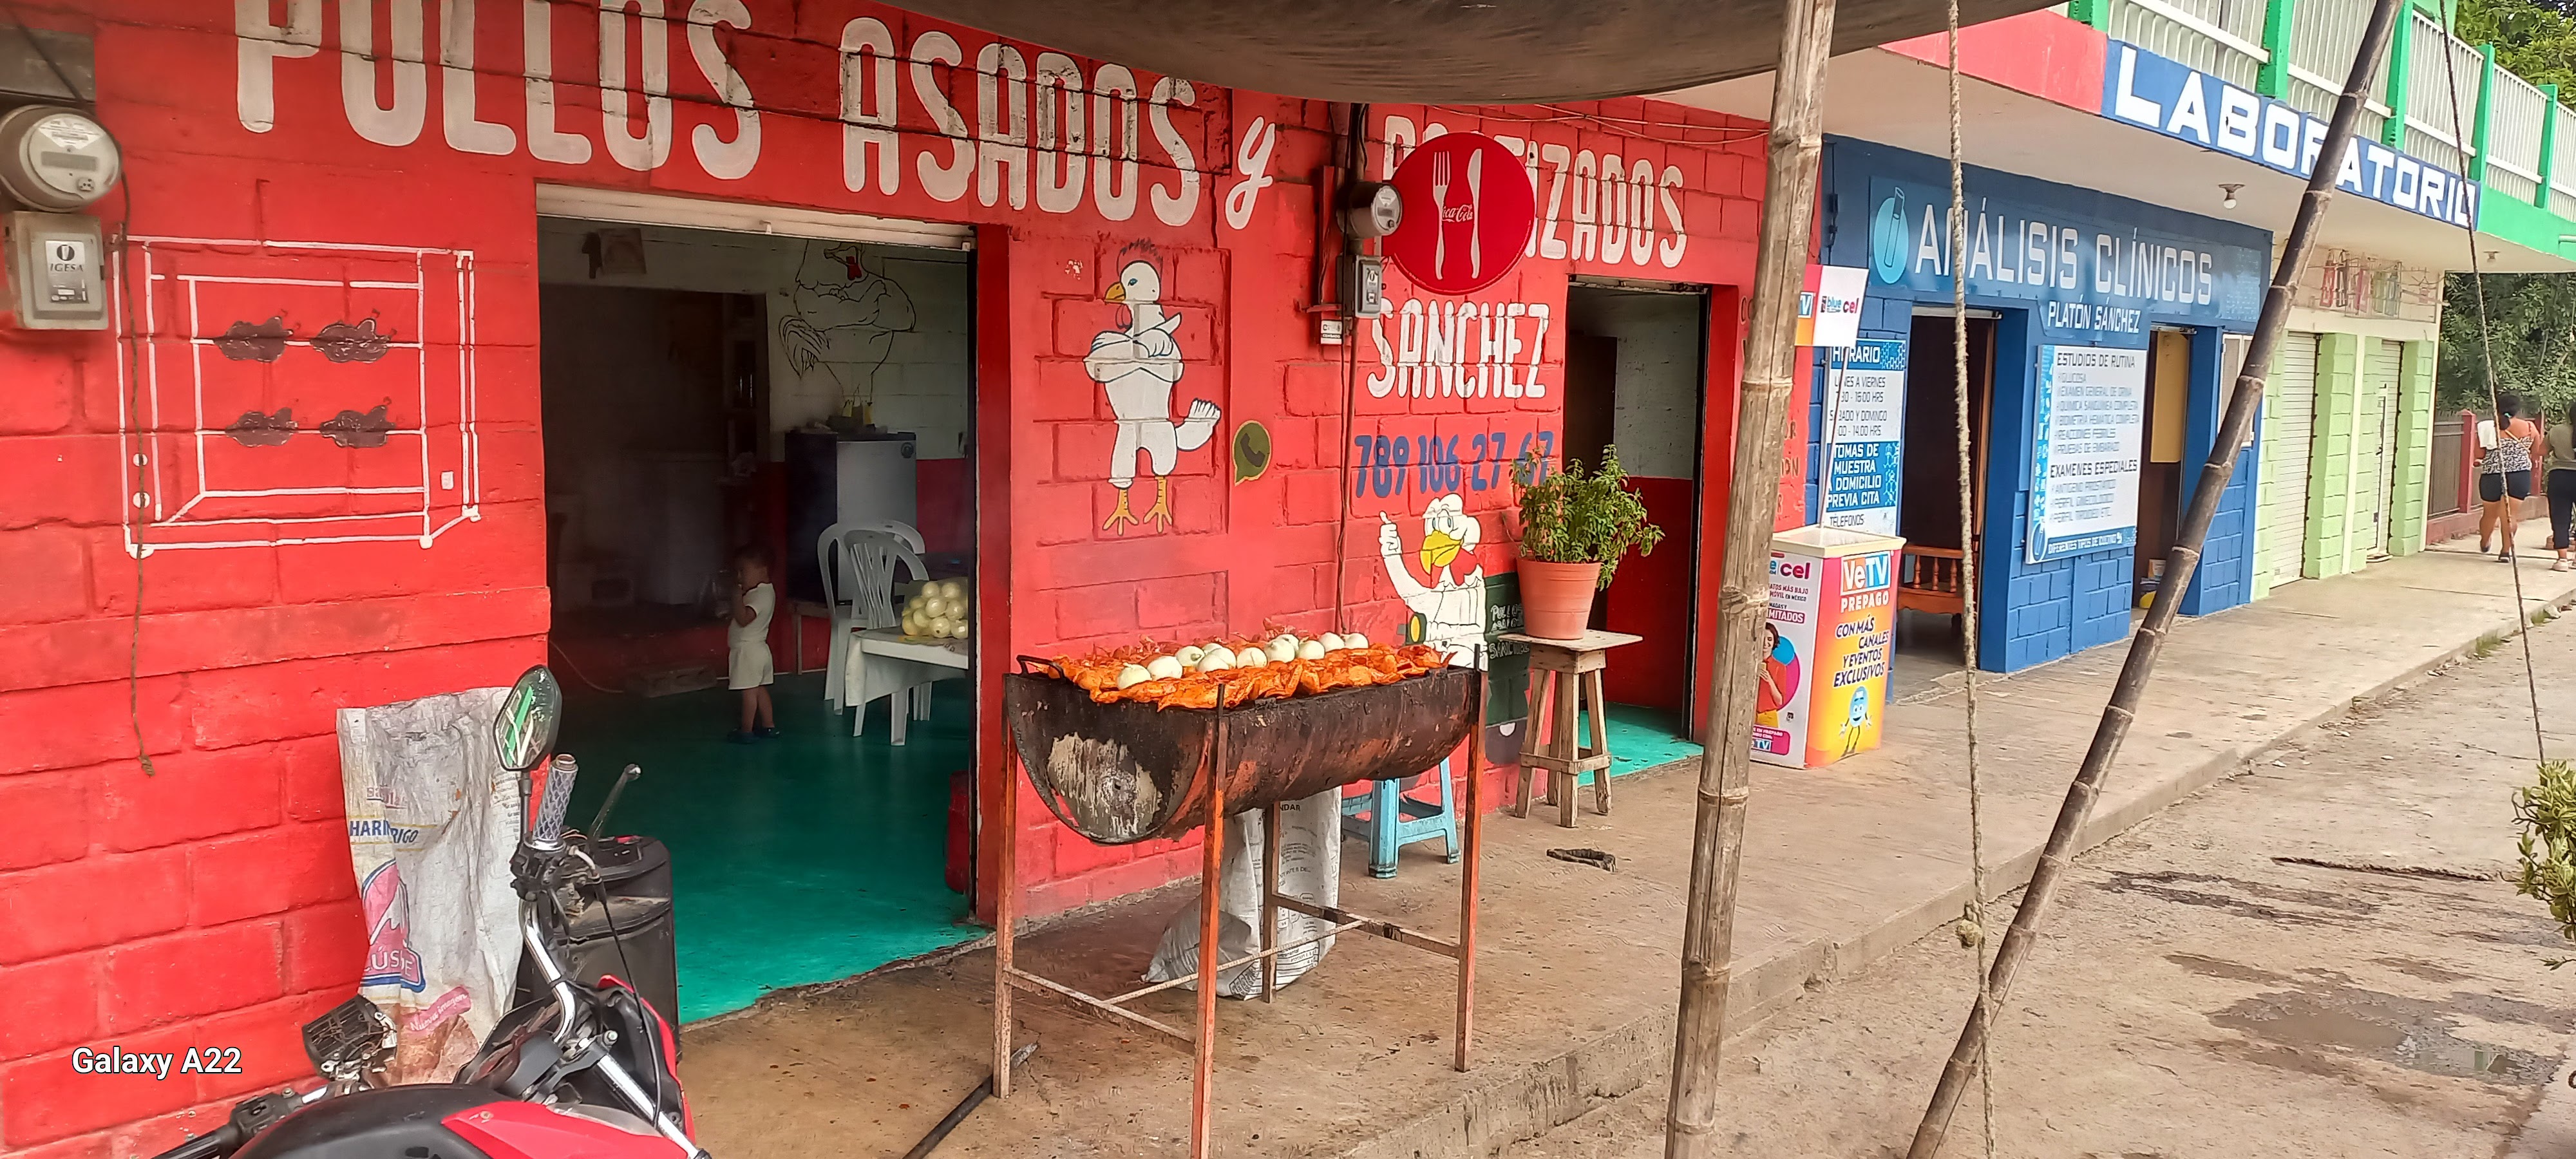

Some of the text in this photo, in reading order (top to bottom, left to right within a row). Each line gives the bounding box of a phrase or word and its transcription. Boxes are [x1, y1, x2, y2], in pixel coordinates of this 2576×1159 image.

[839, 17, 1200, 227] ASADOS
[1915, 197, 2213, 306] ANÁLISIS CLÍNICOS
[50, 263, 84, 272] IGESA
[2048, 294, 2141, 334] PLATÓN SÁNCHEZ
[1367, 298, 1549, 399] SANCHEZ
[1833, 346, 1880, 363] HRARIO
[2057, 352, 2136, 368] ESTUDIOS DE RUTINA
[1834, 443, 1879, 458] TOMAS DE
[1354, 434, 1410, 498] 789
[1417, 433, 1461, 494] 106
[1471, 431, 1506, 491] 27
[1833, 459, 1876, 475] MUESTRA
[2050, 459, 2137, 478] EXAMENES ESPECIALES
[1835, 475, 1882, 491] DOMICILIO
[1827, 491, 1880, 508] PREVIA CITA
[1780, 562, 1811, 580] cel
[1843, 556, 1888, 590] VeTV
[1841, 590, 1889, 613] PREPAGO
[1836, 614, 1875, 638] CON MÁS
[1859, 630, 1889, 649] CANALES
[1843, 648, 1882, 668] Y EVENTOS
[1833, 662, 1885, 688] EXCLUSIVOS
[409, 993, 468, 1032] Nueva imagen
